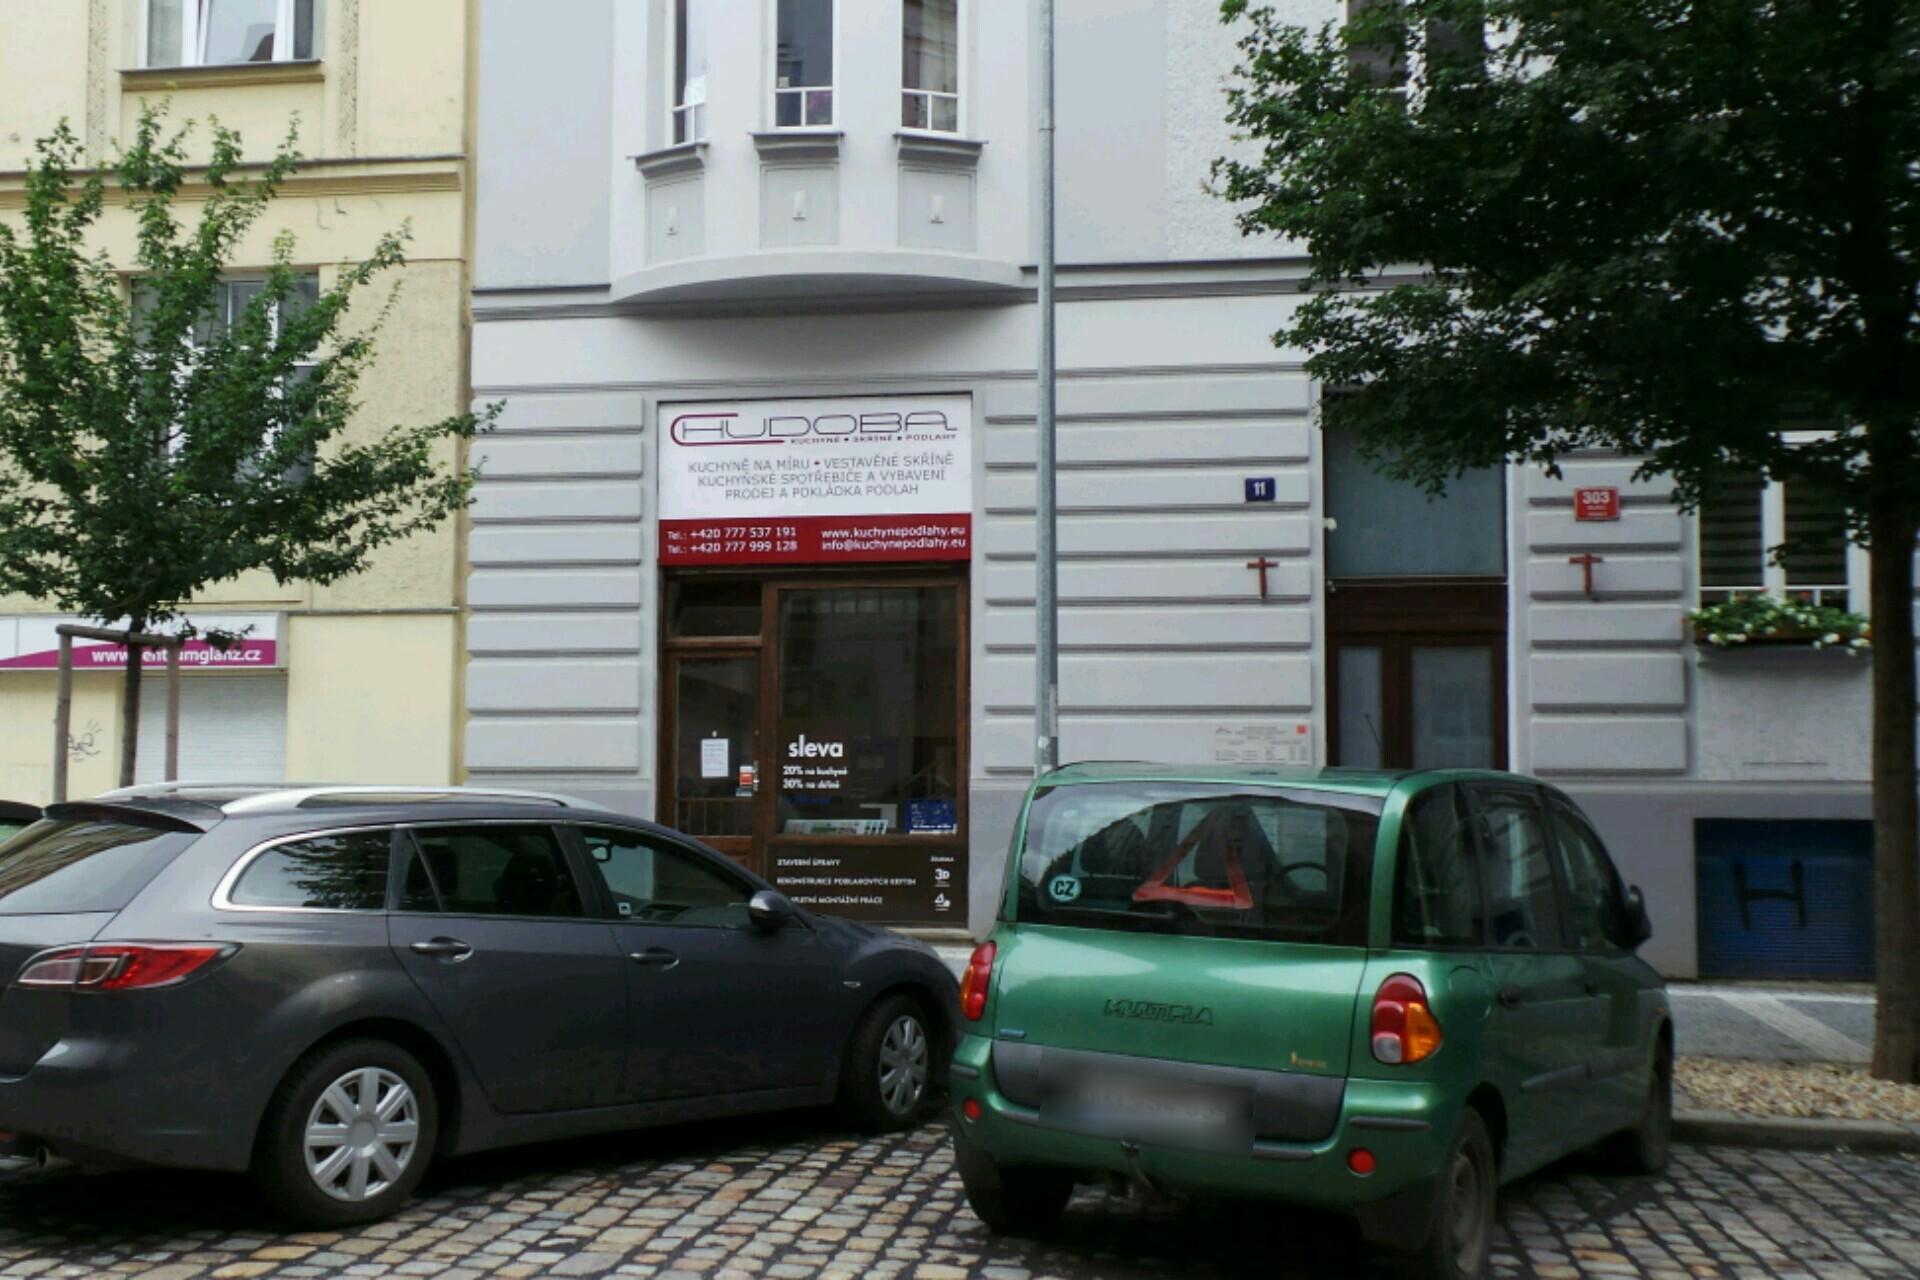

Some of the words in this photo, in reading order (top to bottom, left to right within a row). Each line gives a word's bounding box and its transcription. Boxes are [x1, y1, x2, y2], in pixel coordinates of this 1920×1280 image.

[670, 410, 958, 447] CHUDOBA
[905, 433, 957, 441] PODLAHY
[688, 457, 749, 473] KUCHYNĚ
[753, 459, 772, 471] NA
[776, 456, 810, 471] MÍRU
[903, 451, 954, 467] SKŘÍNĚ
[867, 471, 876, 482] A
[879, 467, 946, 482] VYBAVENÍ
[725, 487, 774, 501] PRODEJ
[779, 488, 788, 499] A
[793, 484, 862, 499] POKLÁDKA
[866, 483, 919, 497] PODLAH
[1253, 481, 1267, 497] 11
[1582, 491, 1610, 504] 303
[690, 528, 721, 539] +420
[724, 527, 746, 538] 777
[749, 526, 771, 538] 537
[776, 526, 796, 537] 191
[821, 525, 966, 539] www.kuchynepodlahy.eu
[690, 542, 721, 553] +420
[724, 541, 746, 552] 777
[749, 541, 772, 552] 999
[776, 540, 798, 552] 128
[822, 537, 966, 551] info@kuchynepodlahy.eu
[788, 734, 844, 758] sleva
[783, 766, 803, 775] 20%
[783, 779, 803, 789] 30%
[1055, 880, 1076, 897] CZ
